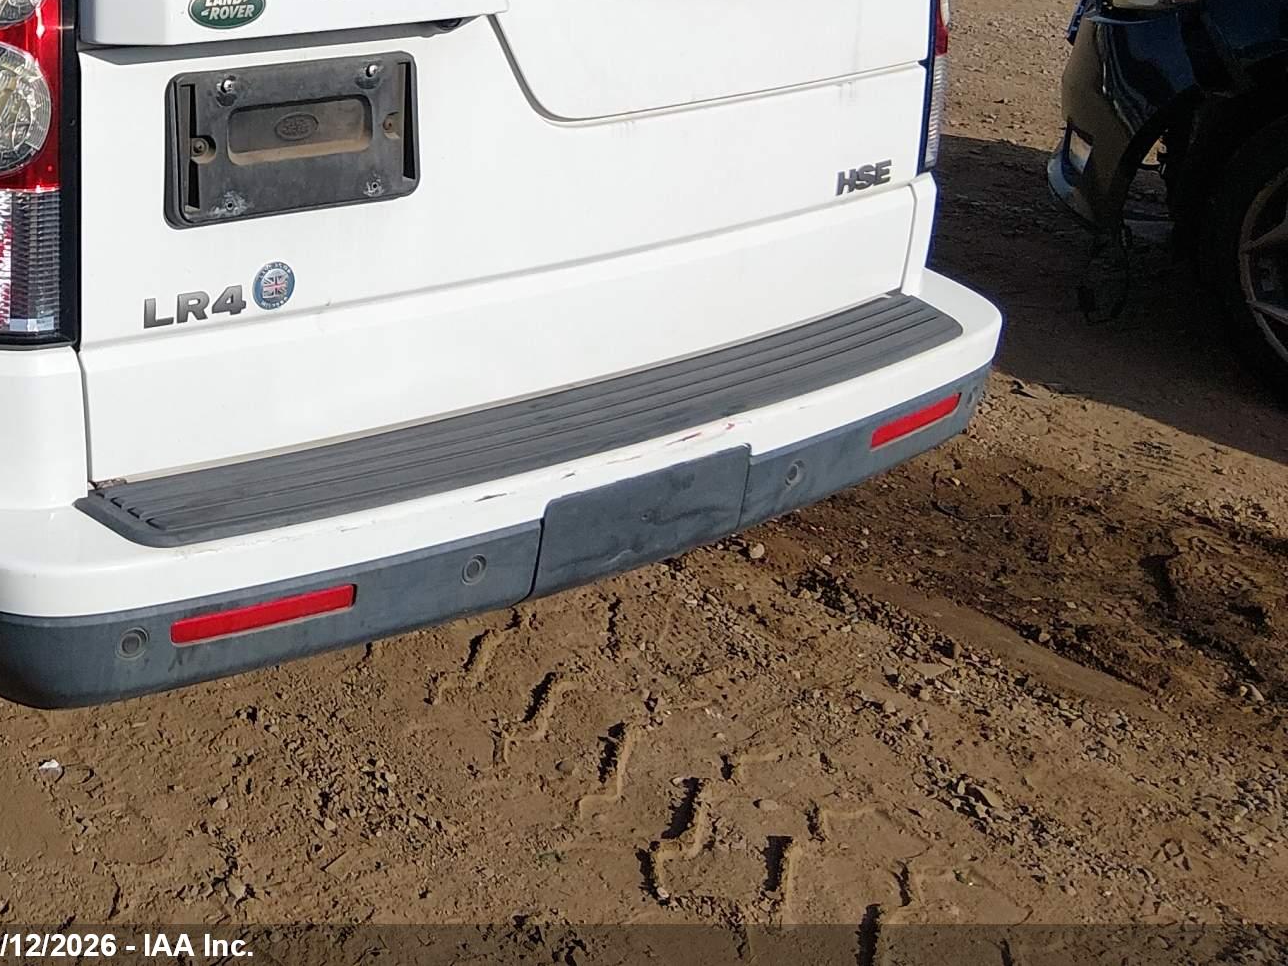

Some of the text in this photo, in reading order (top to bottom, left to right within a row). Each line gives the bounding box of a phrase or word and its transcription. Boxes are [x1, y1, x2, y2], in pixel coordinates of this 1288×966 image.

[209, 4, 255, 20] ROVER
[835, 159, 892, 196] HSE
[143, 284, 246, 329] LR4
